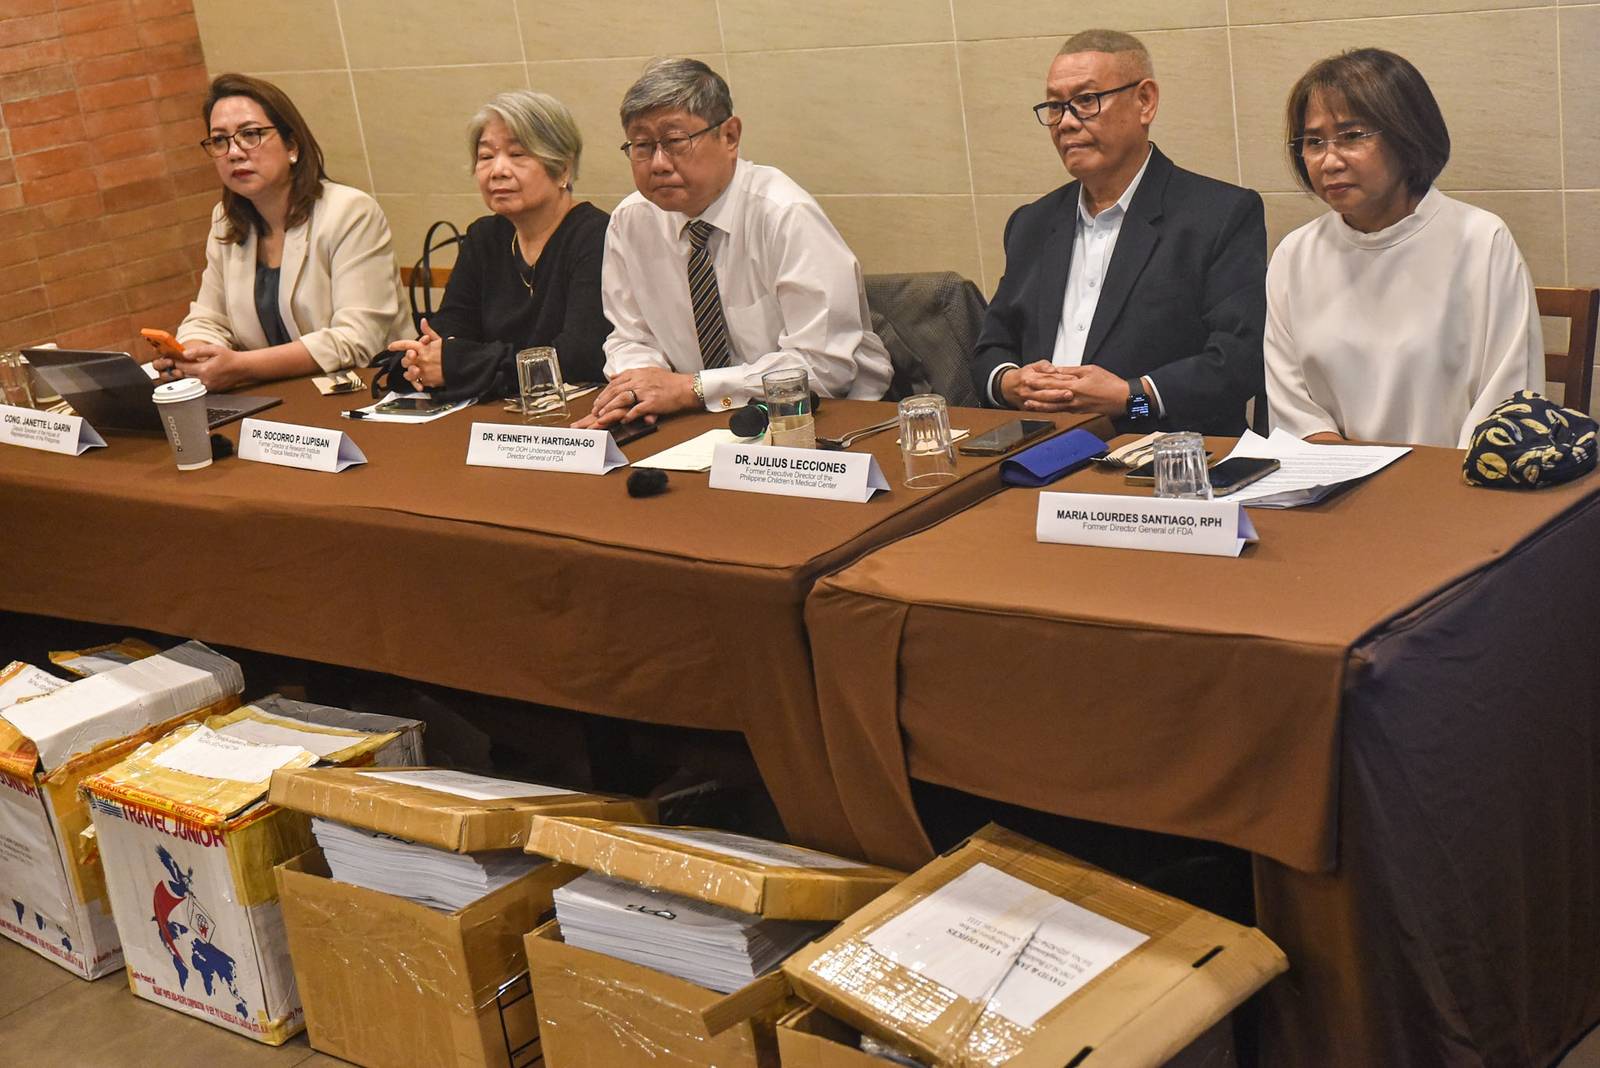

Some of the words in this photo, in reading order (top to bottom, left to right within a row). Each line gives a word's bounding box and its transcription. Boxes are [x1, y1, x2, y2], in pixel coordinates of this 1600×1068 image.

[4, 414, 21, 424] CONG.
[22, 417, 47, 429] JANETTE
[54, 423, 71, 432] GARIN
[252, 429, 262, 439] DR.
[264, 431, 294, 443] SOCORRO
[296, 435, 300, 443] P.
[302, 436, 330, 448] LUPISAN
[482, 433, 495, 441] DR.
[497, 433, 532, 444] KENNETH
[533, 436, 540, 444] Y.
[542, 437, 595, 447] HARTIGAN-GO
[529, 446, 566, 456] Undersecretary
[735, 454, 751, 465] DR.
[754, 456, 787, 468] JULIUS
[790, 460, 846, 474] LECCIONES
[739, 473, 766, 484] Philippine
[767, 475, 794, 485] Children's
[795, 478, 817, 487] Medical
[818, 480, 837, 489] Center
[746, 467, 766, 476] Former
[767, 468, 793, 478] Executive
[794, 471, 816, 480] Director
[1057, 510, 1088, 520] MARIA
[1091, 512, 1138, 524] LOURDES
[1141, 514, 1197, 527] SANTIAGO,
[1200, 517, 1222, 528] RPH
[1082, 522, 1108, 531] Former
[1109, 523, 1137, 533] Director
[1139, 525, 1166, 535] General
[1168, 526, 1175, 535] of
[1177, 528, 1193, 536] FDA
[122, 806, 170, 835] TRAVEL
[174, 818, 226, 847] JUNIOR
